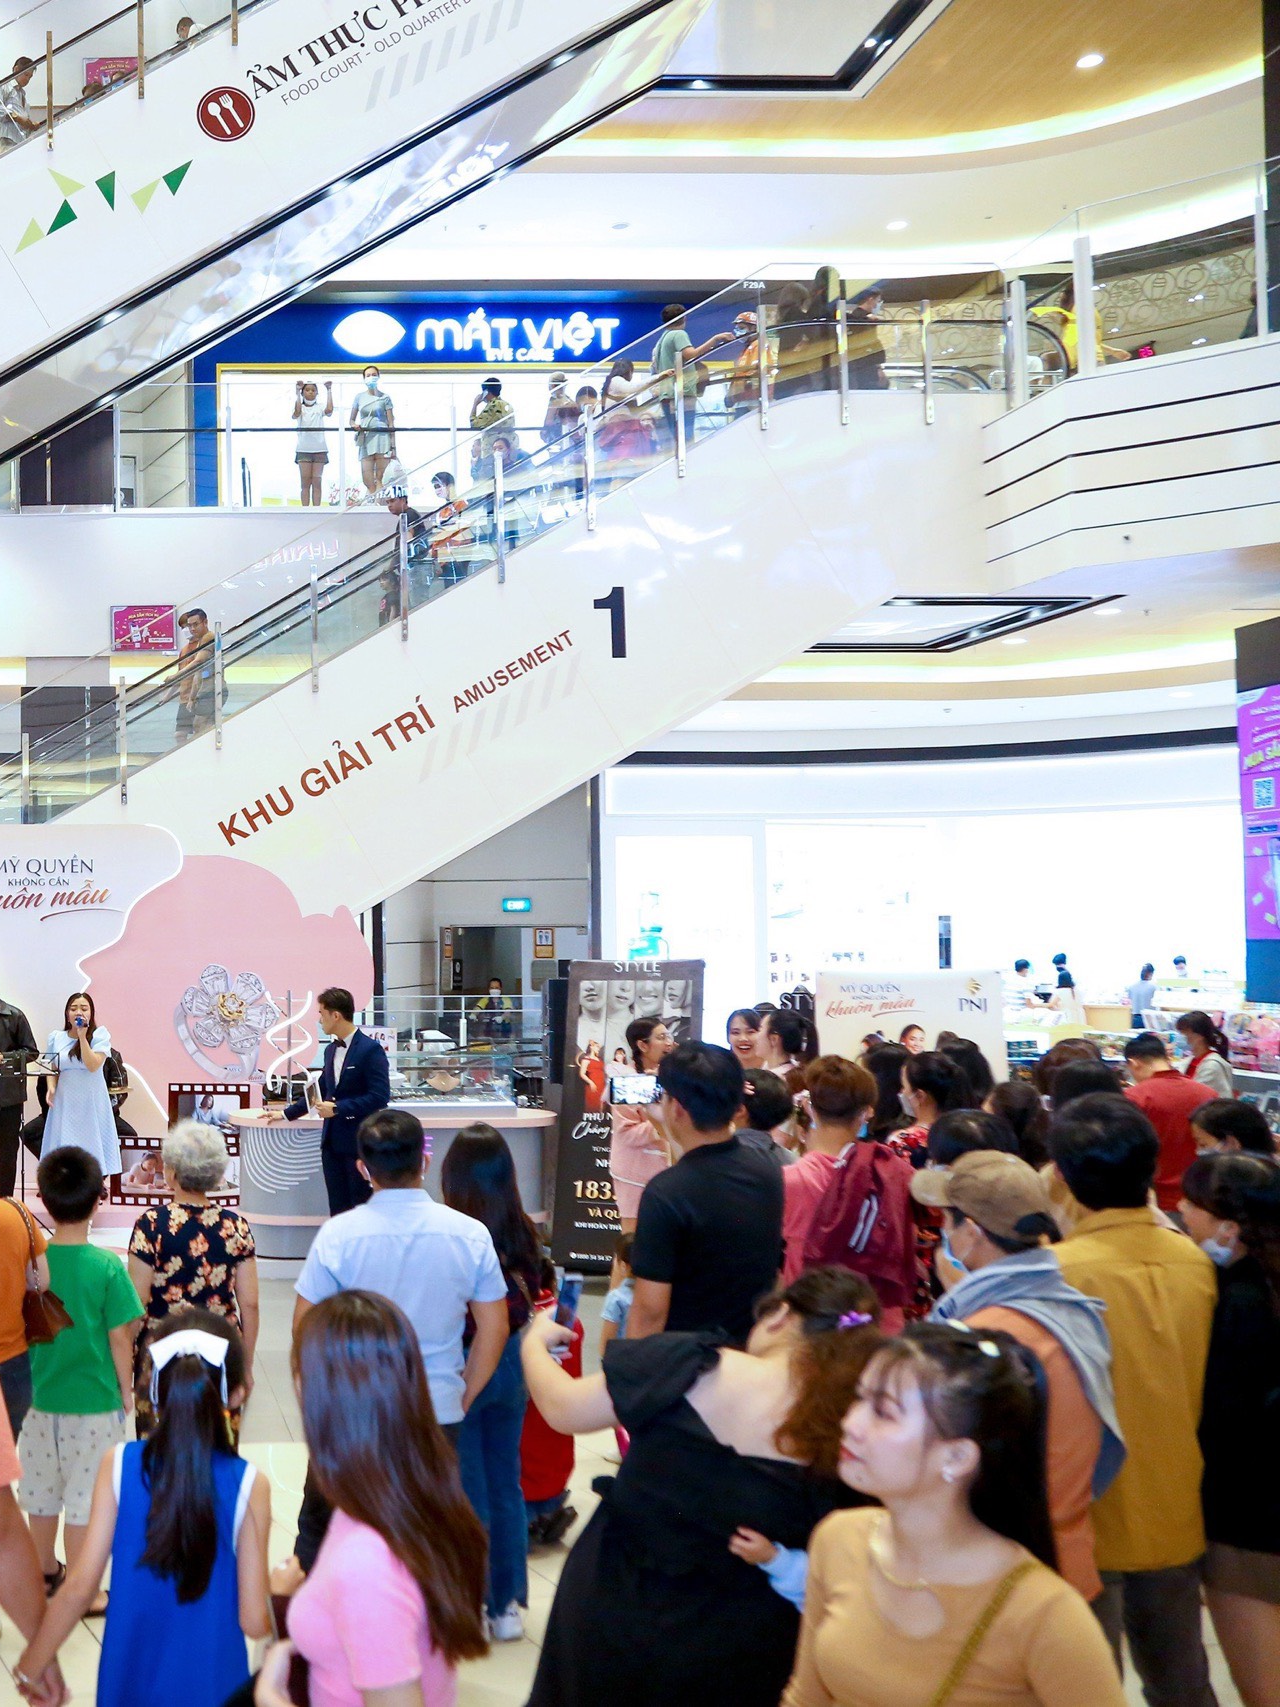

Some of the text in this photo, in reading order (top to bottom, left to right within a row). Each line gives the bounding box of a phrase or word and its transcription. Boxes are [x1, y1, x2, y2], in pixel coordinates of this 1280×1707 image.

[246, 54, 302, 100] ẨM
[298, 4, 388, 67] THỰC
[281, 78, 319, 105] FOOD
[320, 52, 365, 83] COURT
[374, 31, 402, 53] OLD
[402, 0, 462, 36] QUARTER
[743, 281, 766, 289] F29A
[515, 348, 555, 361] CARE
[593, 586, 627, 659] 1
[218, 629, 575, 847] KHU GIẢI TRÍ AMUSEMENT
[26, 853, 94, 876] QUYỀN
[8, 876, 46, 887] KHÔNG
[50, 879, 111, 907] mẫu
[614, 960, 661, 973] STYLE
[826, 999, 873, 1018] khuôn
[958, 998, 987, 1014] PNJ
